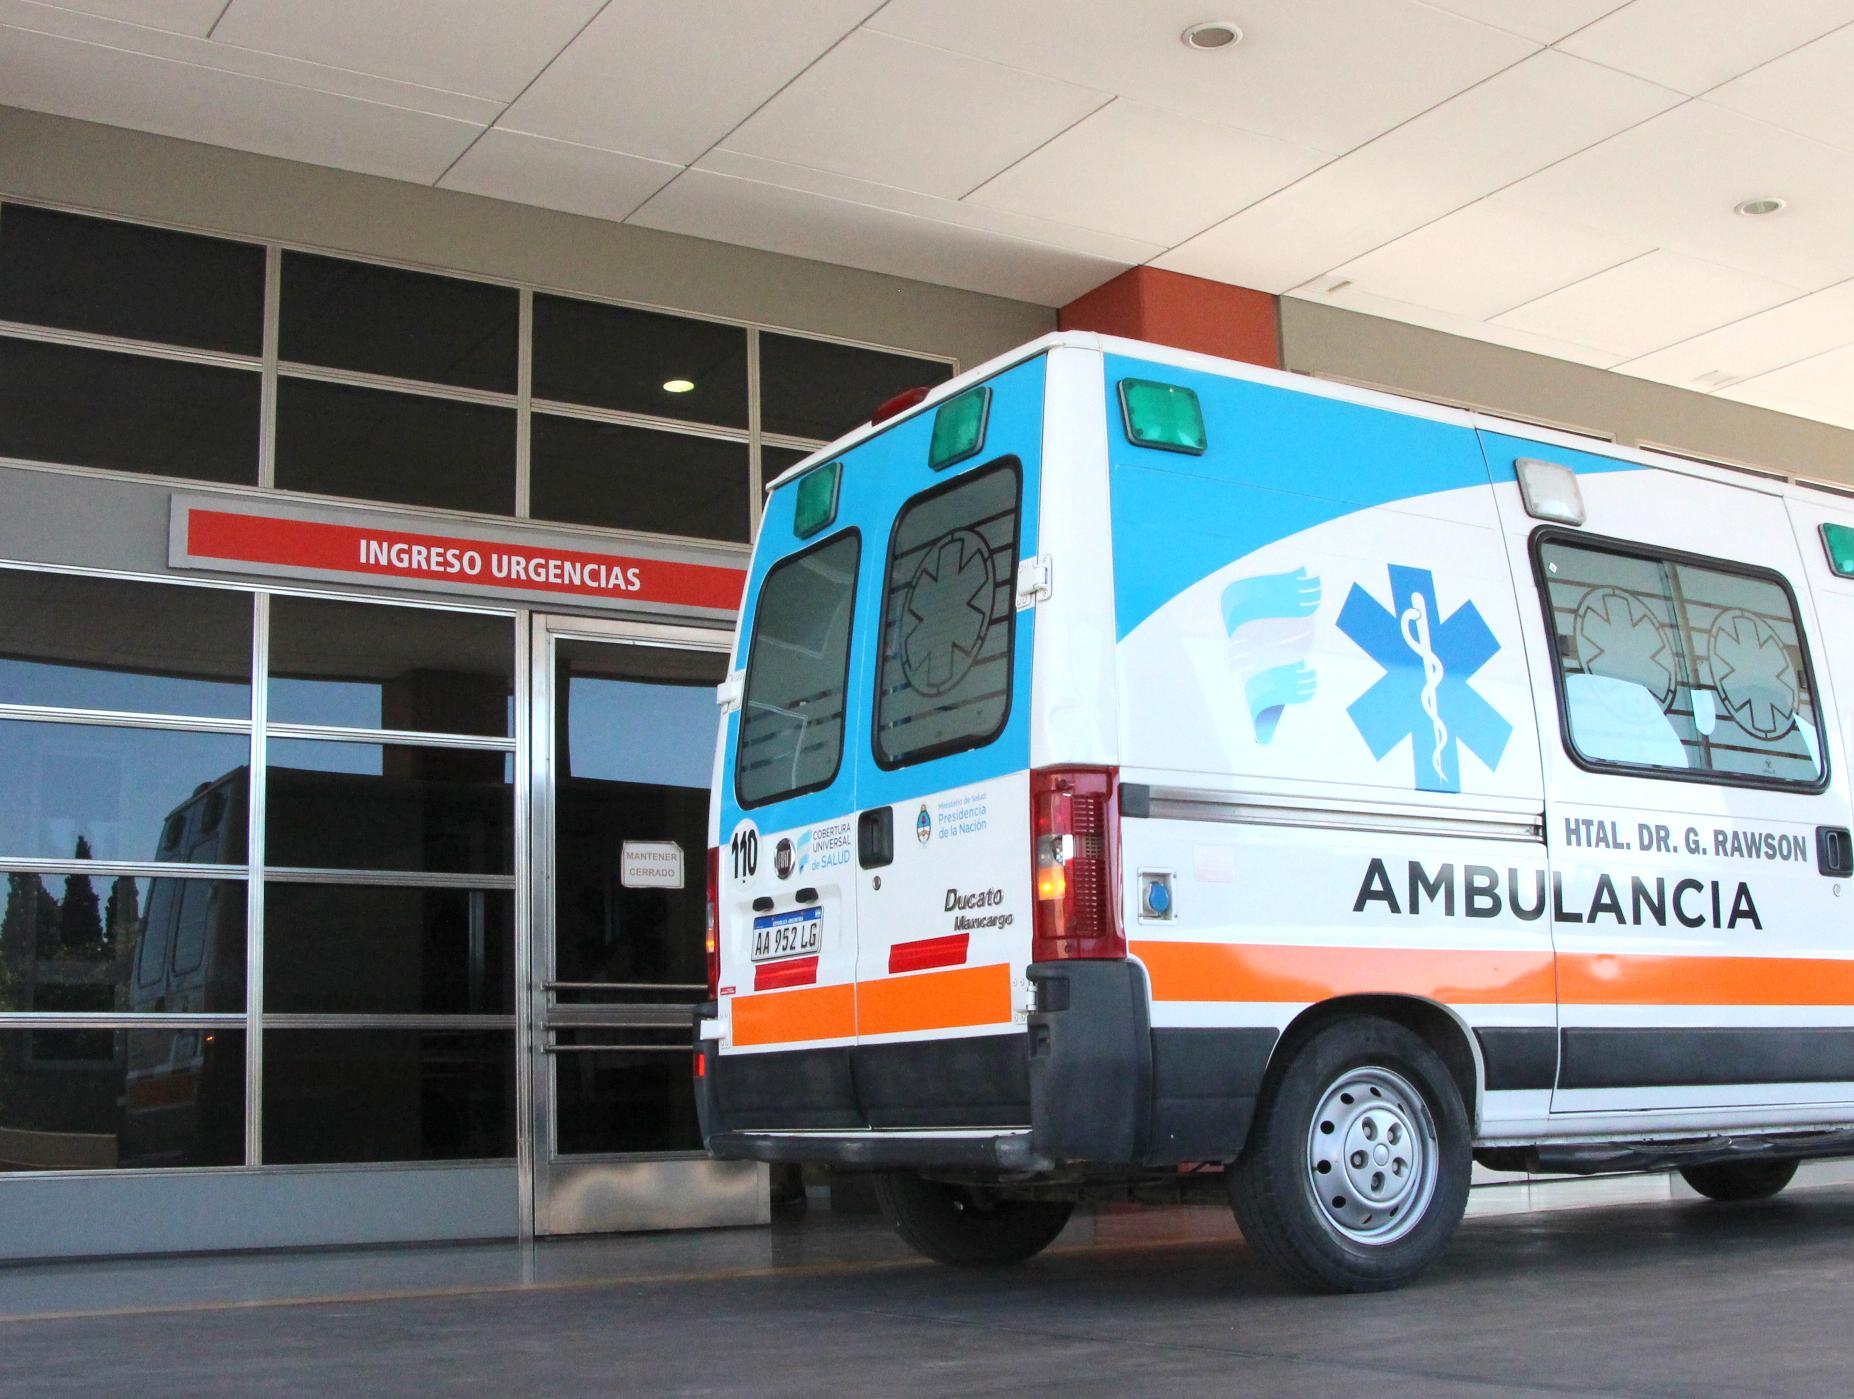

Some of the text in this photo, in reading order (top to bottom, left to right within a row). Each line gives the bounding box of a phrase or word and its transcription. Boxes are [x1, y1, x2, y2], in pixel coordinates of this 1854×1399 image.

[360, 539, 641, 591] INGRESO URGENCIAS
[938, 805, 987, 824] Presidencia
[812, 823, 851, 841] COBERTURA
[938, 819, 987, 839] de la Nación
[1564, 817, 1808, 862] HTAL. DR. G. RAWSON
[731, 829, 758, 879] 110
[812, 836, 852, 853] UNIVERSAL
[626, 852, 678, 862] MANTENER
[811, 850, 850, 871] de SALUD
[629, 867, 676, 878] CERRADO
[944, 887, 1004, 912] Ducato
[1352, 857, 1764, 931] AMBULANCIA
[755, 922, 817, 956] AA 952 LG
